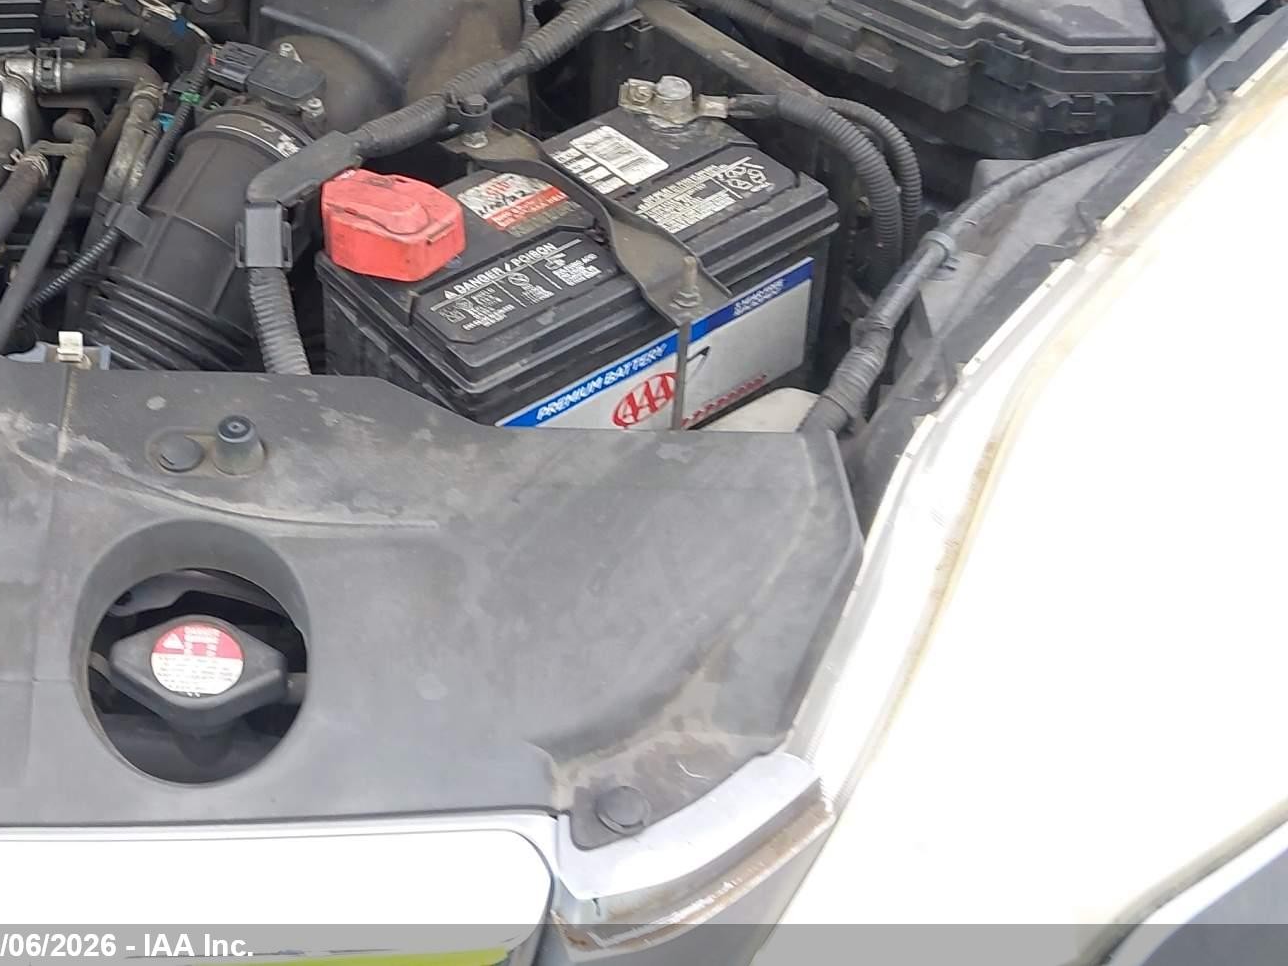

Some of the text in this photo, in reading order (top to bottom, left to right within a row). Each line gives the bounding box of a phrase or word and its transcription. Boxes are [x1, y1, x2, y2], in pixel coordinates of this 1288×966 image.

[453, 266, 506, 294] DANGER
[510, 242, 558, 267] POISON
[536, 376, 603, 420] PREMIUM
[603, 343, 668, 385] BATTERY
[620, 375, 675, 423] AAA
